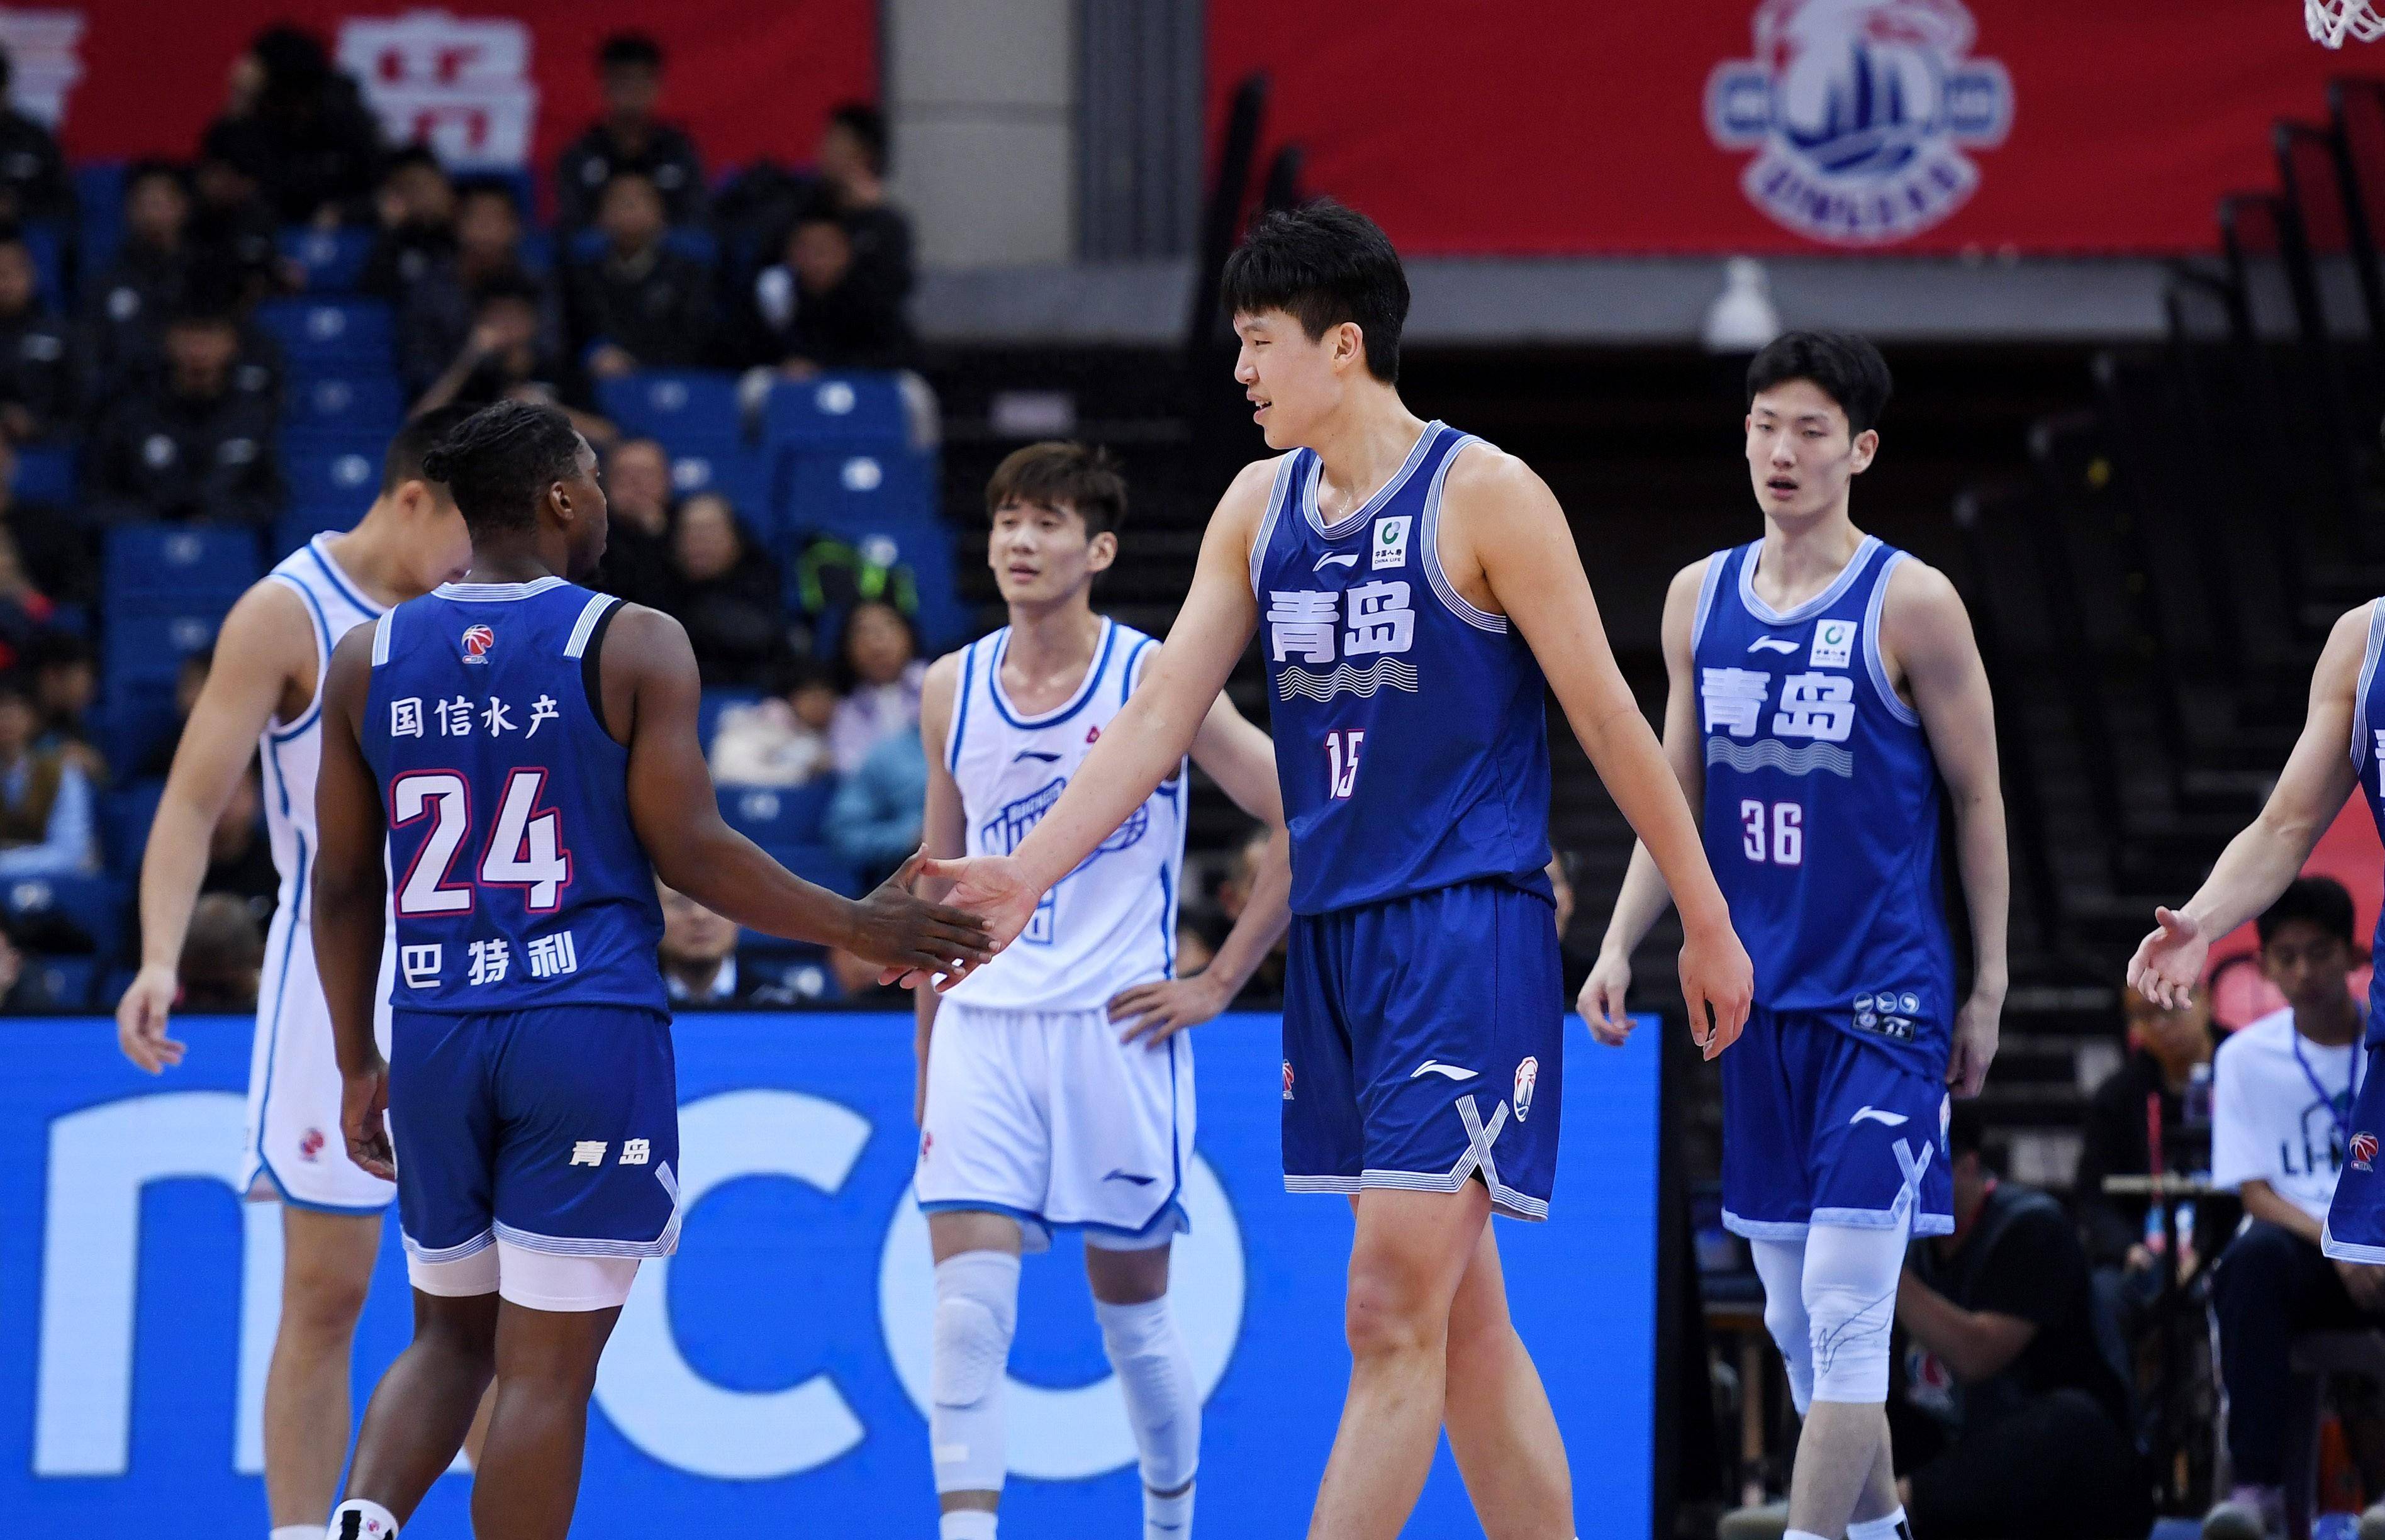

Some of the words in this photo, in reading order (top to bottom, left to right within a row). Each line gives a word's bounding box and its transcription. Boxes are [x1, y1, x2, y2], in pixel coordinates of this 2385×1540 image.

[1266, 580, 1415, 663] 青岛
[391, 694, 559, 739] 国信水产
[1701, 667, 1855, 742] 青岛
[1324, 728, 1365, 800] 15
[389, 767, 573, 917] 24
[1740, 799, 1802, 866] 36
[401, 930, 578, 989] 巴特利
[568, 1137, 651, 1167] 青岛
